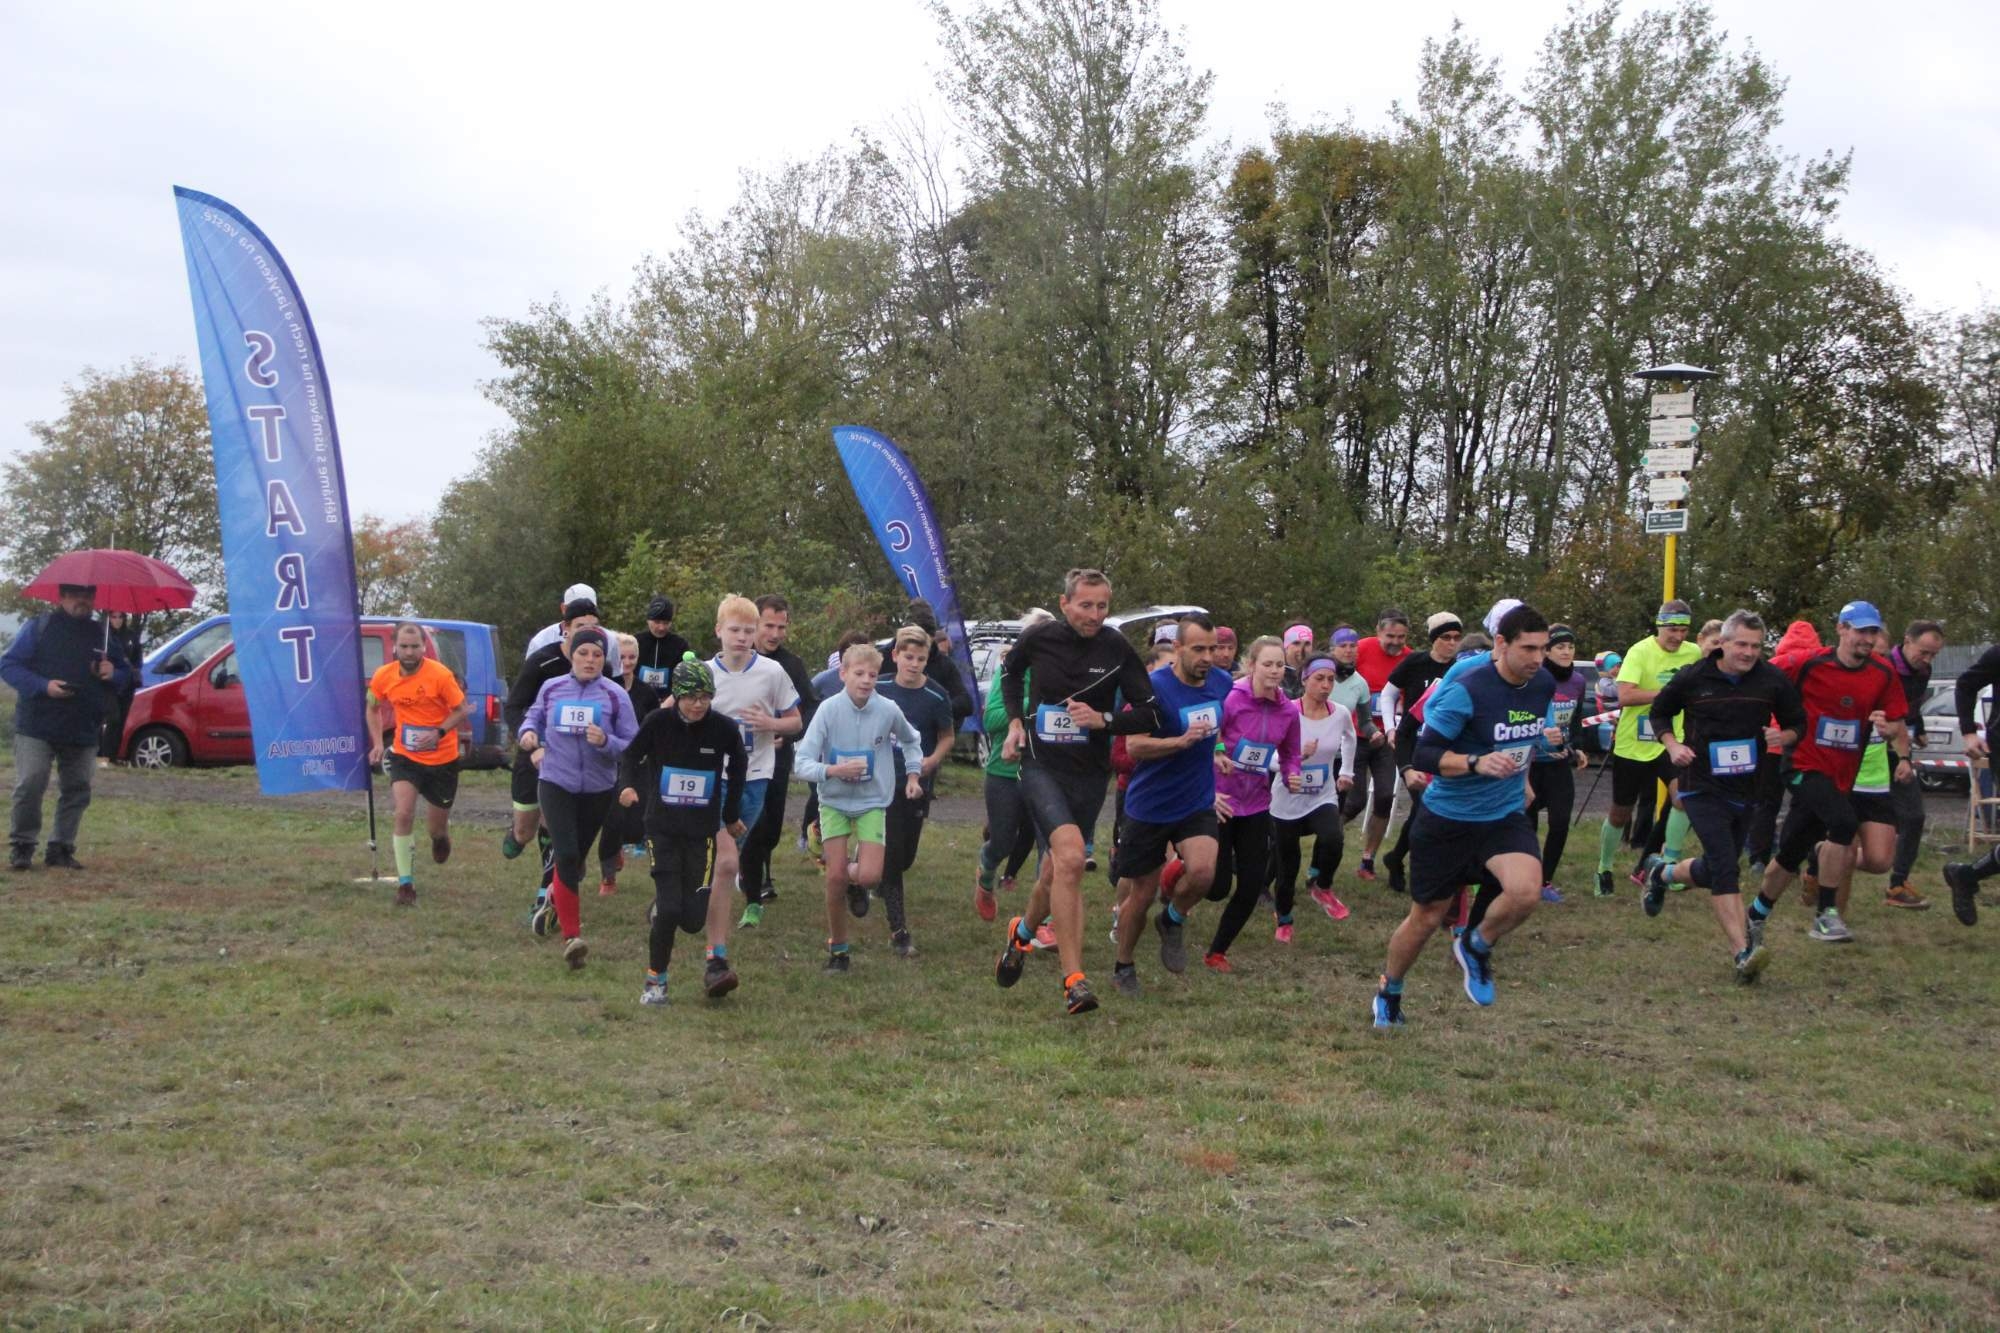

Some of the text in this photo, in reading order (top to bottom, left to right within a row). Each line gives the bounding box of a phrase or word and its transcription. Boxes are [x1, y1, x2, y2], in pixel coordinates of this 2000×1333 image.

[570, 711, 585, 722] 18
[1053, 717, 1071, 729] 42
[1494, 717, 1546, 741] CrossF
[1834, 729, 1848, 739] 17
[1247, 751, 1261, 761] 28
[1731, 750, 1739, 761] 6
[1305, 774, 1313, 783] 9
[680, 780, 696, 792] 19
